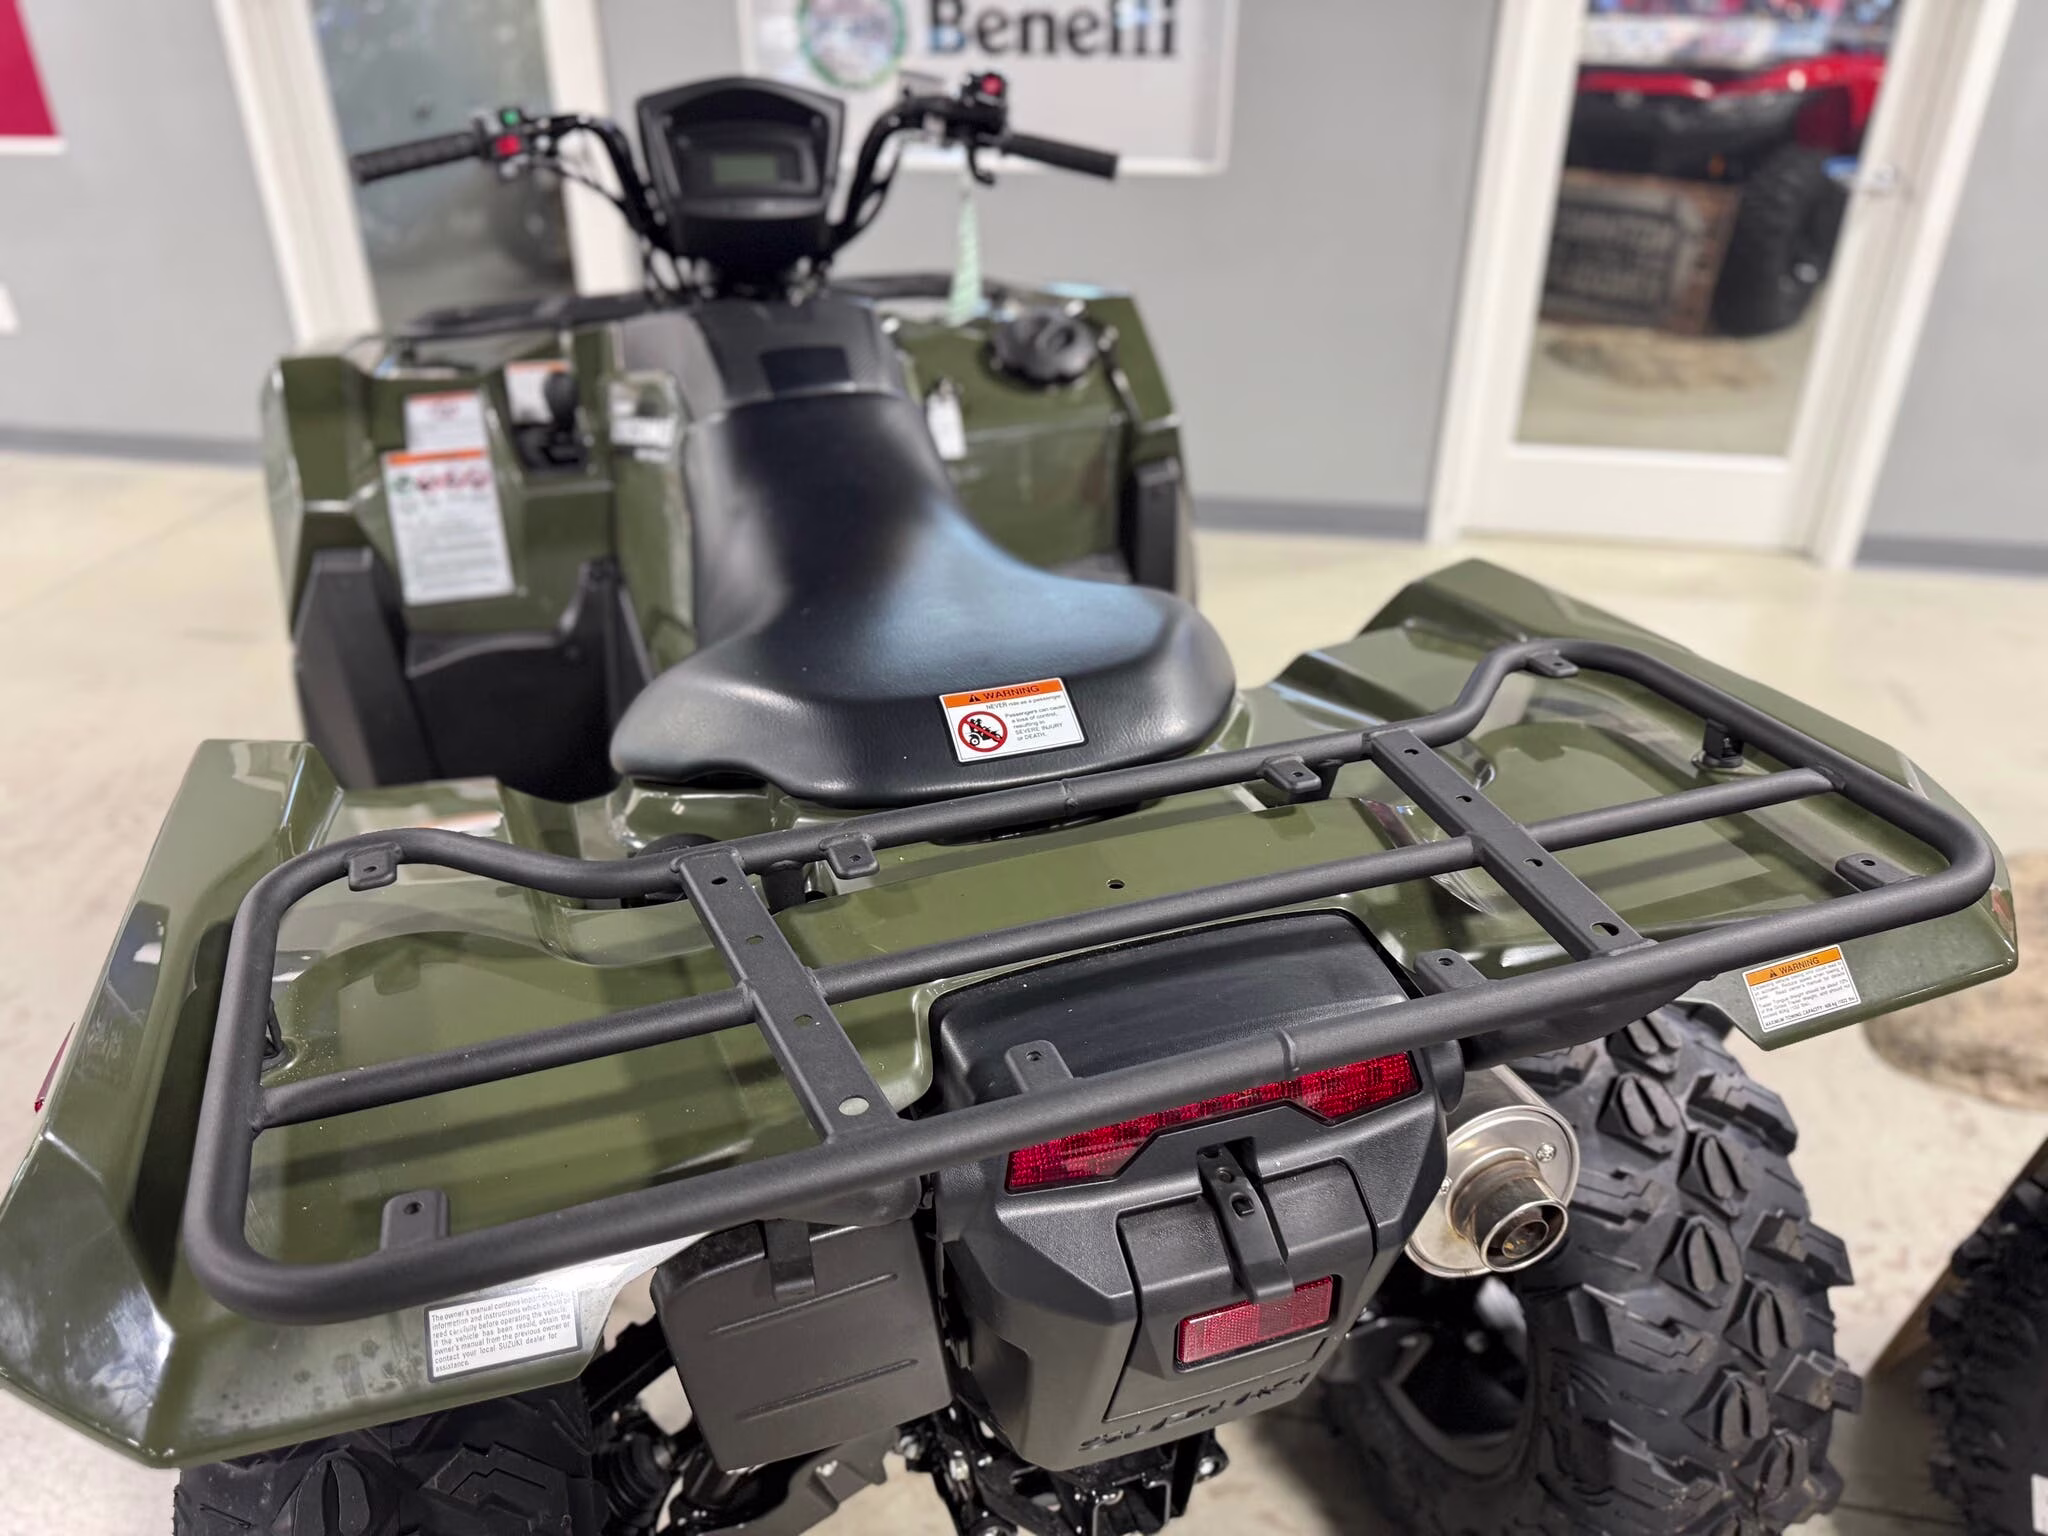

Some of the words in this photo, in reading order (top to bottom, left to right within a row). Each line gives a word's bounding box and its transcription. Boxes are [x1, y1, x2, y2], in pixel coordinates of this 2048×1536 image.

[983, 686, 1039, 699] WARNING
[1779, 957, 1820, 974] WARNING
[470, 1304, 493, 1314] manual
[494, 1300, 520, 1310] contains
[470, 1314, 482, 1323] and
[484, 1308, 520, 1320] instructions
[522, 1303, 540, 1312] which
[456, 1332, 479, 1342] vehicle
[497, 1326, 513, 1334] been
[539, 1316, 558, 1325] obtain
[478, 1320, 499, 1329] before
[500, 1314, 530, 1325] operating
[461, 1339, 484, 1349] manual
[514, 1328, 540, 1340] previous
[542, 1324, 562, 1332] owner
[435, 1353, 460, 1364] contact
[462, 1350, 476, 1359] your
[480, 1345, 496, 1354] local
[499, 1339, 522, 1350] SUZUKI
[526, 1335, 545, 1344] dealer
